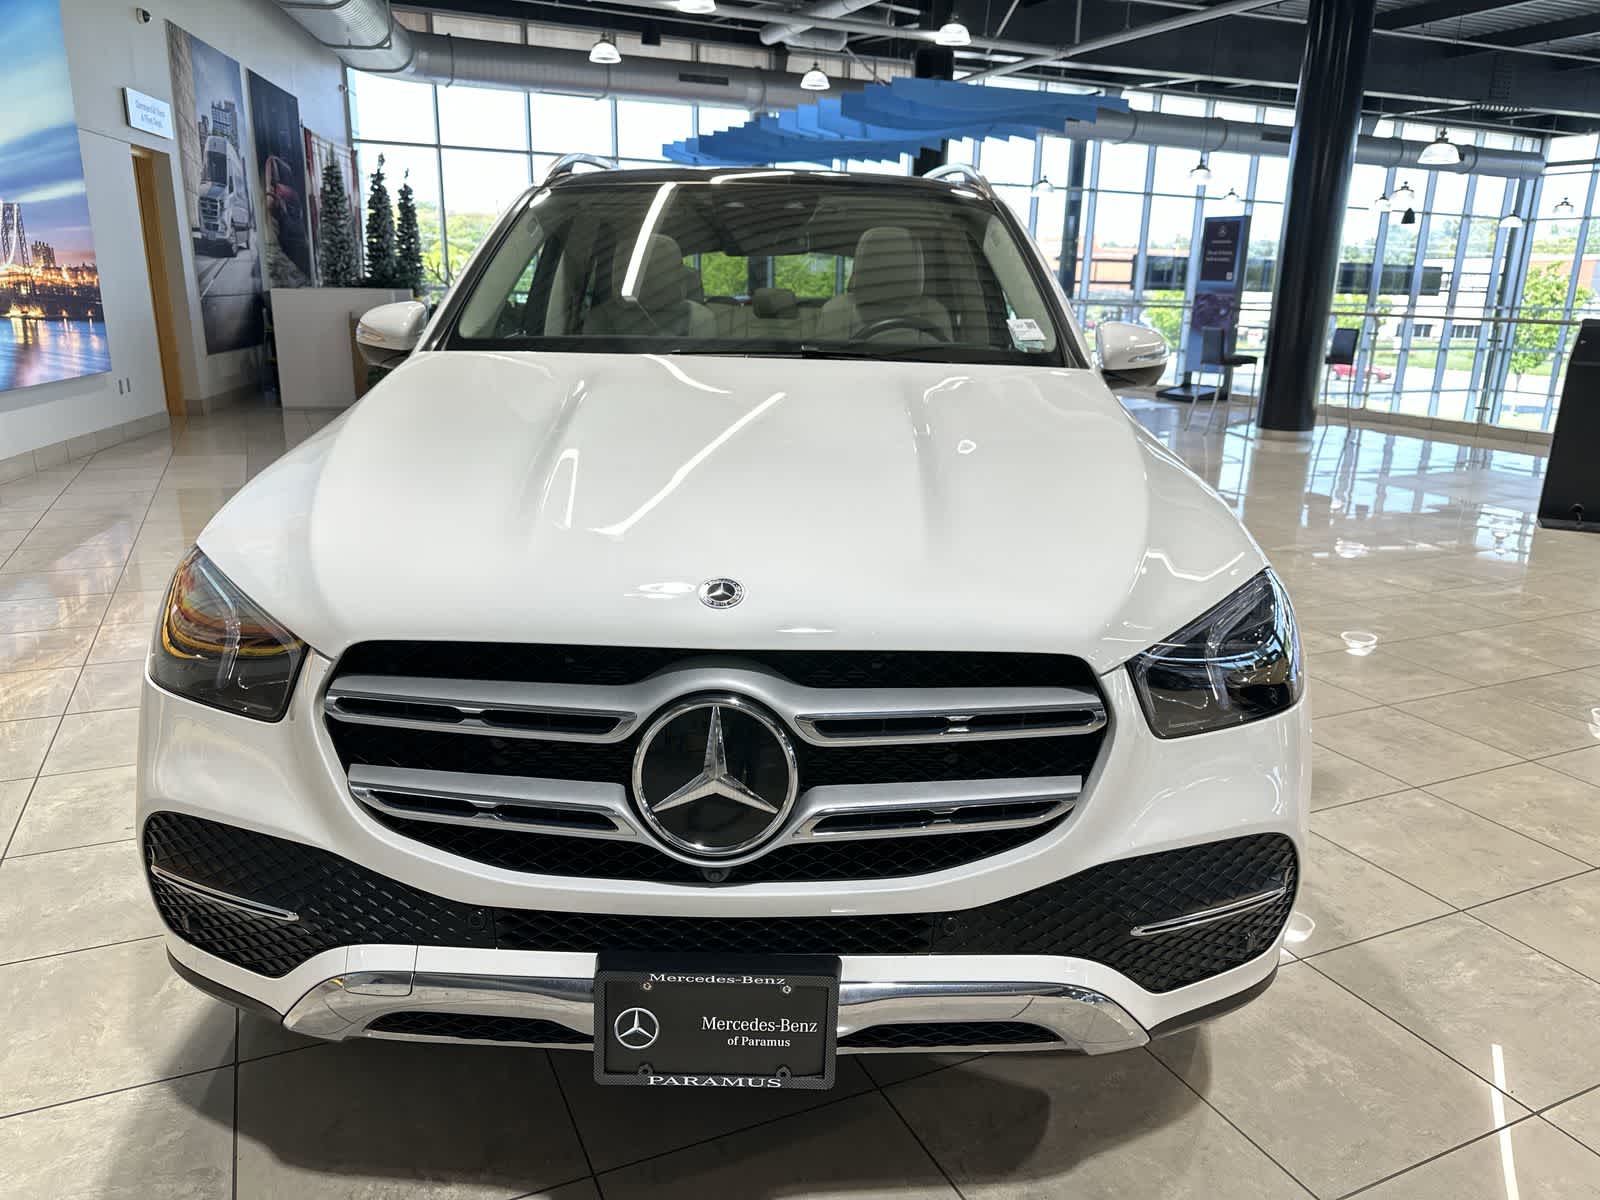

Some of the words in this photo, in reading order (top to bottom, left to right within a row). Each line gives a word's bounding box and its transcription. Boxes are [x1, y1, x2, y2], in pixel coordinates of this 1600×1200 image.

[649, 973, 786, 985] Mercedes-Benz
[701, 1016, 818, 1033] Mercedes-Benz
[727, 1036, 739, 1047] of
[741, 1036, 791, 1047] Paramus
[647, 1075, 782, 1088] PARAMUS
